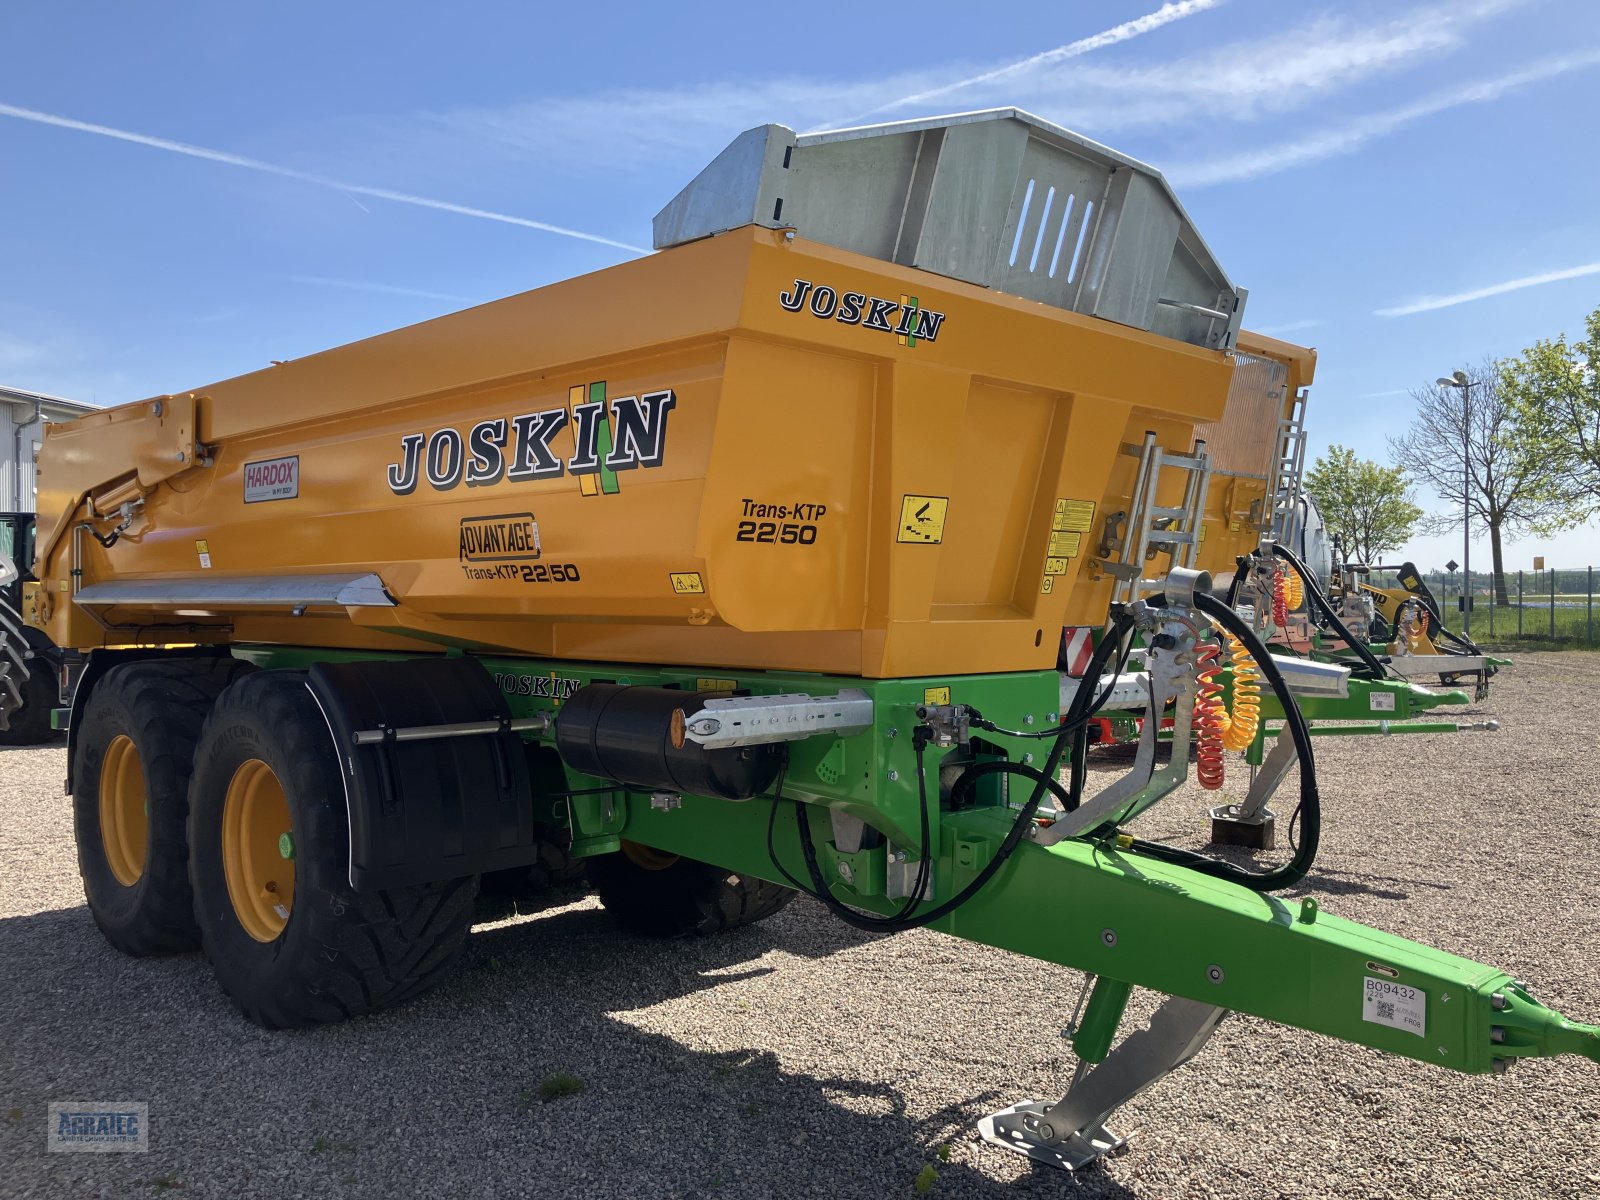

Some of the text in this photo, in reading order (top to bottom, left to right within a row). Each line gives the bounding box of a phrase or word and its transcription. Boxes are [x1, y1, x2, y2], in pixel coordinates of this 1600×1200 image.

[779, 278, 945, 342] JOSKIN
[387, 389, 677, 496] JOSKIN
[741, 499, 826, 521] Trans-KTP
[459, 522, 534, 562] ADVANTAGE
[736, 521, 817, 545] 22/50
[462, 563, 580, 584] Trans-KTP 22/50
[1366, 979, 1415, 1000] B09432
